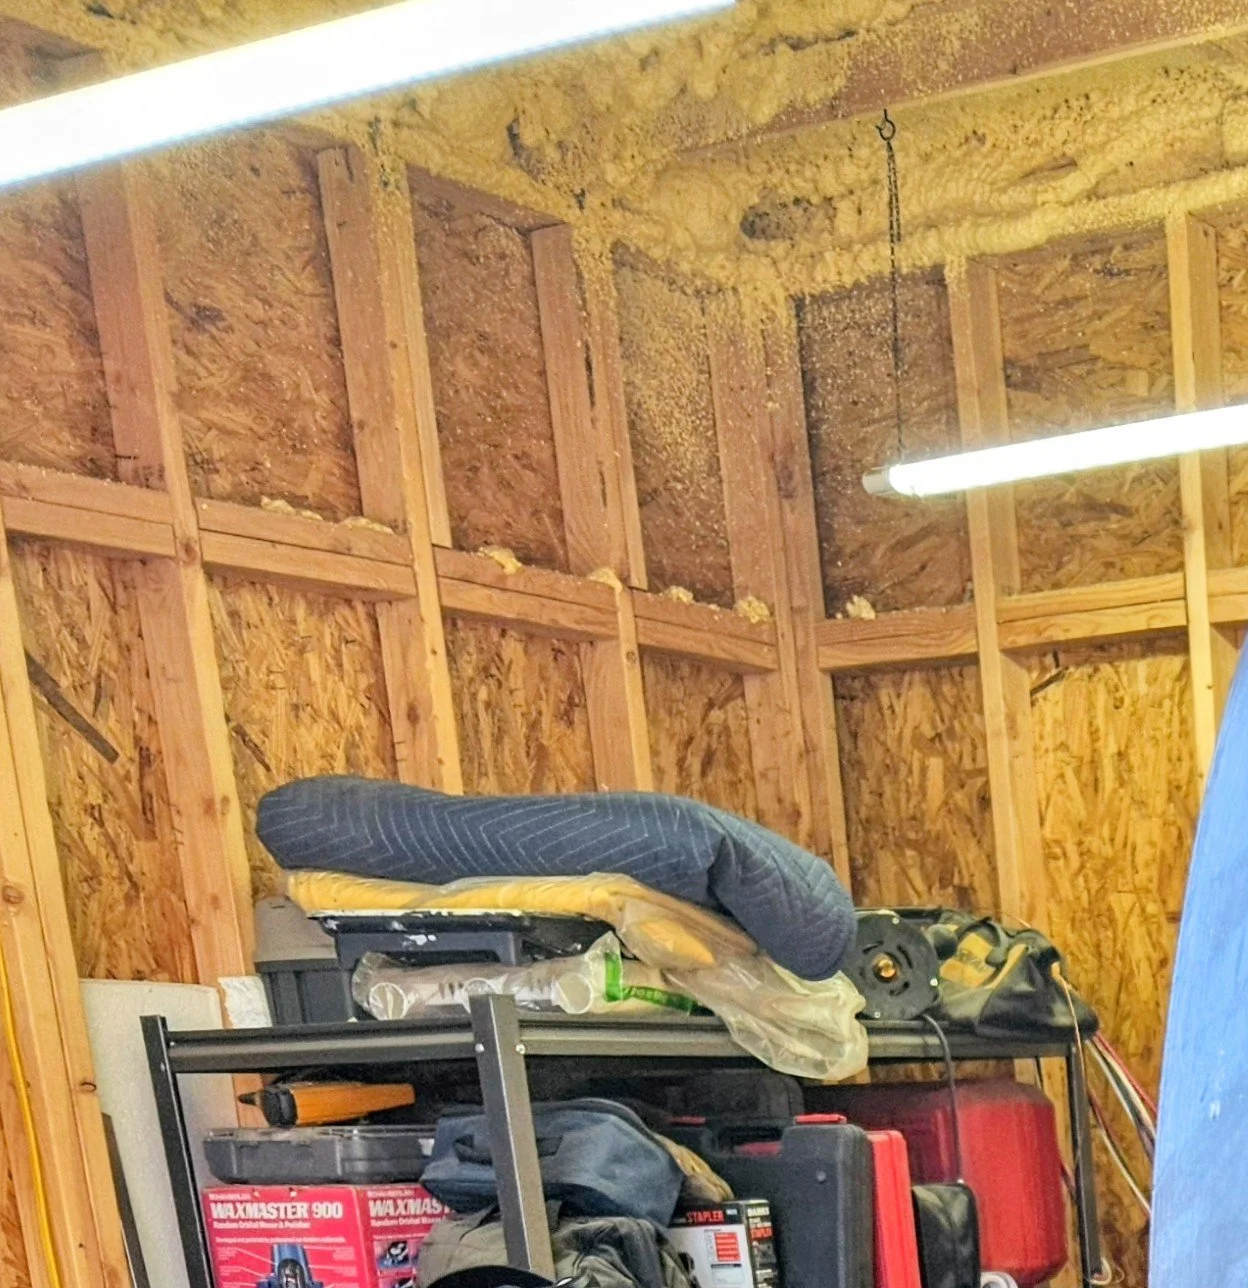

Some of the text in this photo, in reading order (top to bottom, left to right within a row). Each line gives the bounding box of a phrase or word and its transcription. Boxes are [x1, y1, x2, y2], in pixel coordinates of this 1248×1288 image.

[210, 1202, 344, 1219] WAXMASTER 900
[686, 1210, 724, 1223] STAPLER
